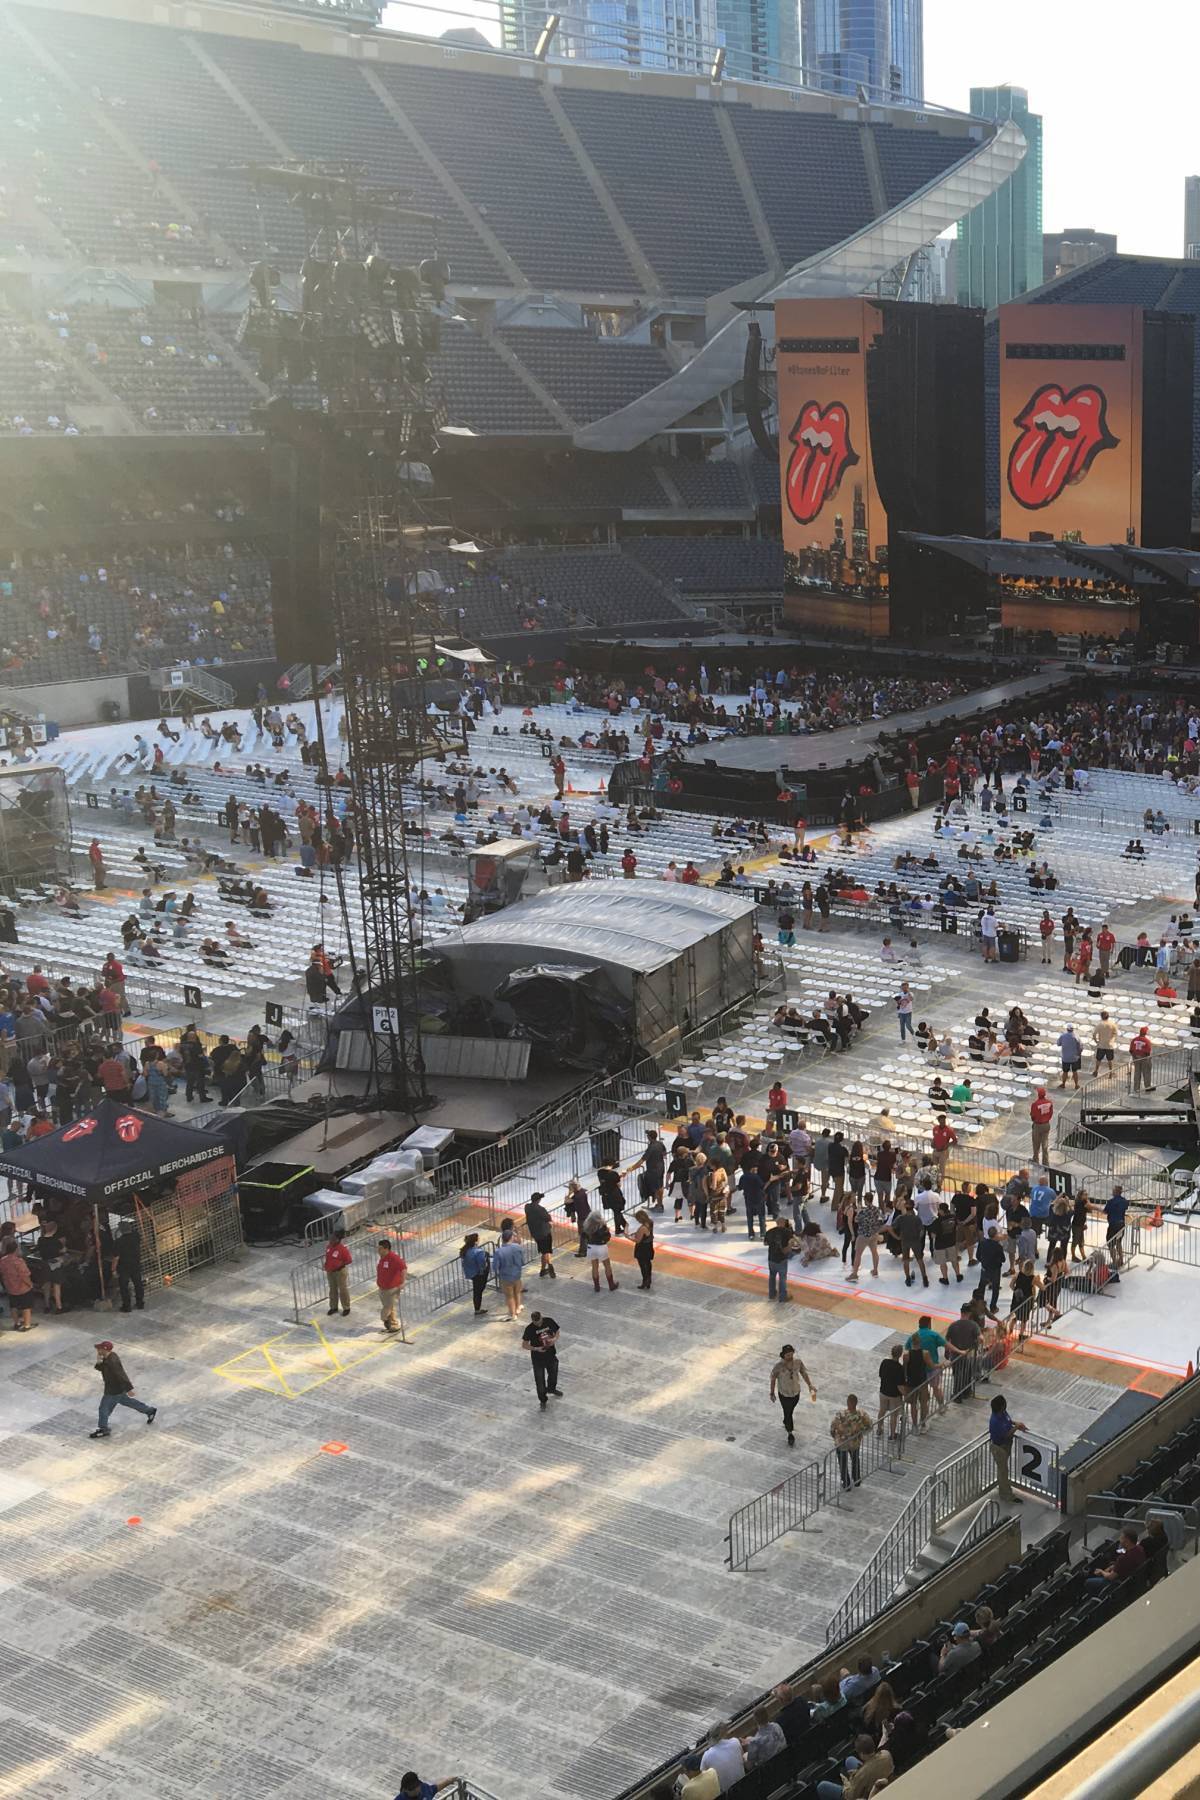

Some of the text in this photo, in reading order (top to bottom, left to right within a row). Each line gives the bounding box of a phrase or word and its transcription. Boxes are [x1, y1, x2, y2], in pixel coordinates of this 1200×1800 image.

[544, 746, 549, 754] D
[89, 796, 96, 806] G
[1016, 800, 1024, 809] B
[221, 814, 227, 825] G
[759, 890, 765, 902] F
[946, 918, 953, 929] F
[1144, 950, 1153, 963] A
[188, 991, 197, 1005] K
[271, 1009, 278, 1022] J
[375, 1009, 395, 1018] PIT 2
[672, 1095, 681, 1111] J
[782, 1114, 793, 1131] H
[103, 1170, 155, 1195] OFFICIAL
[159, 1145, 225, 1175] MERCHANDISE
[0, 1162, 87, 1197] OFFICIAL MERCHANDISE
[1055, 1174, 1066, 1194] H
[1021, 1444, 1042, 1483] 2
